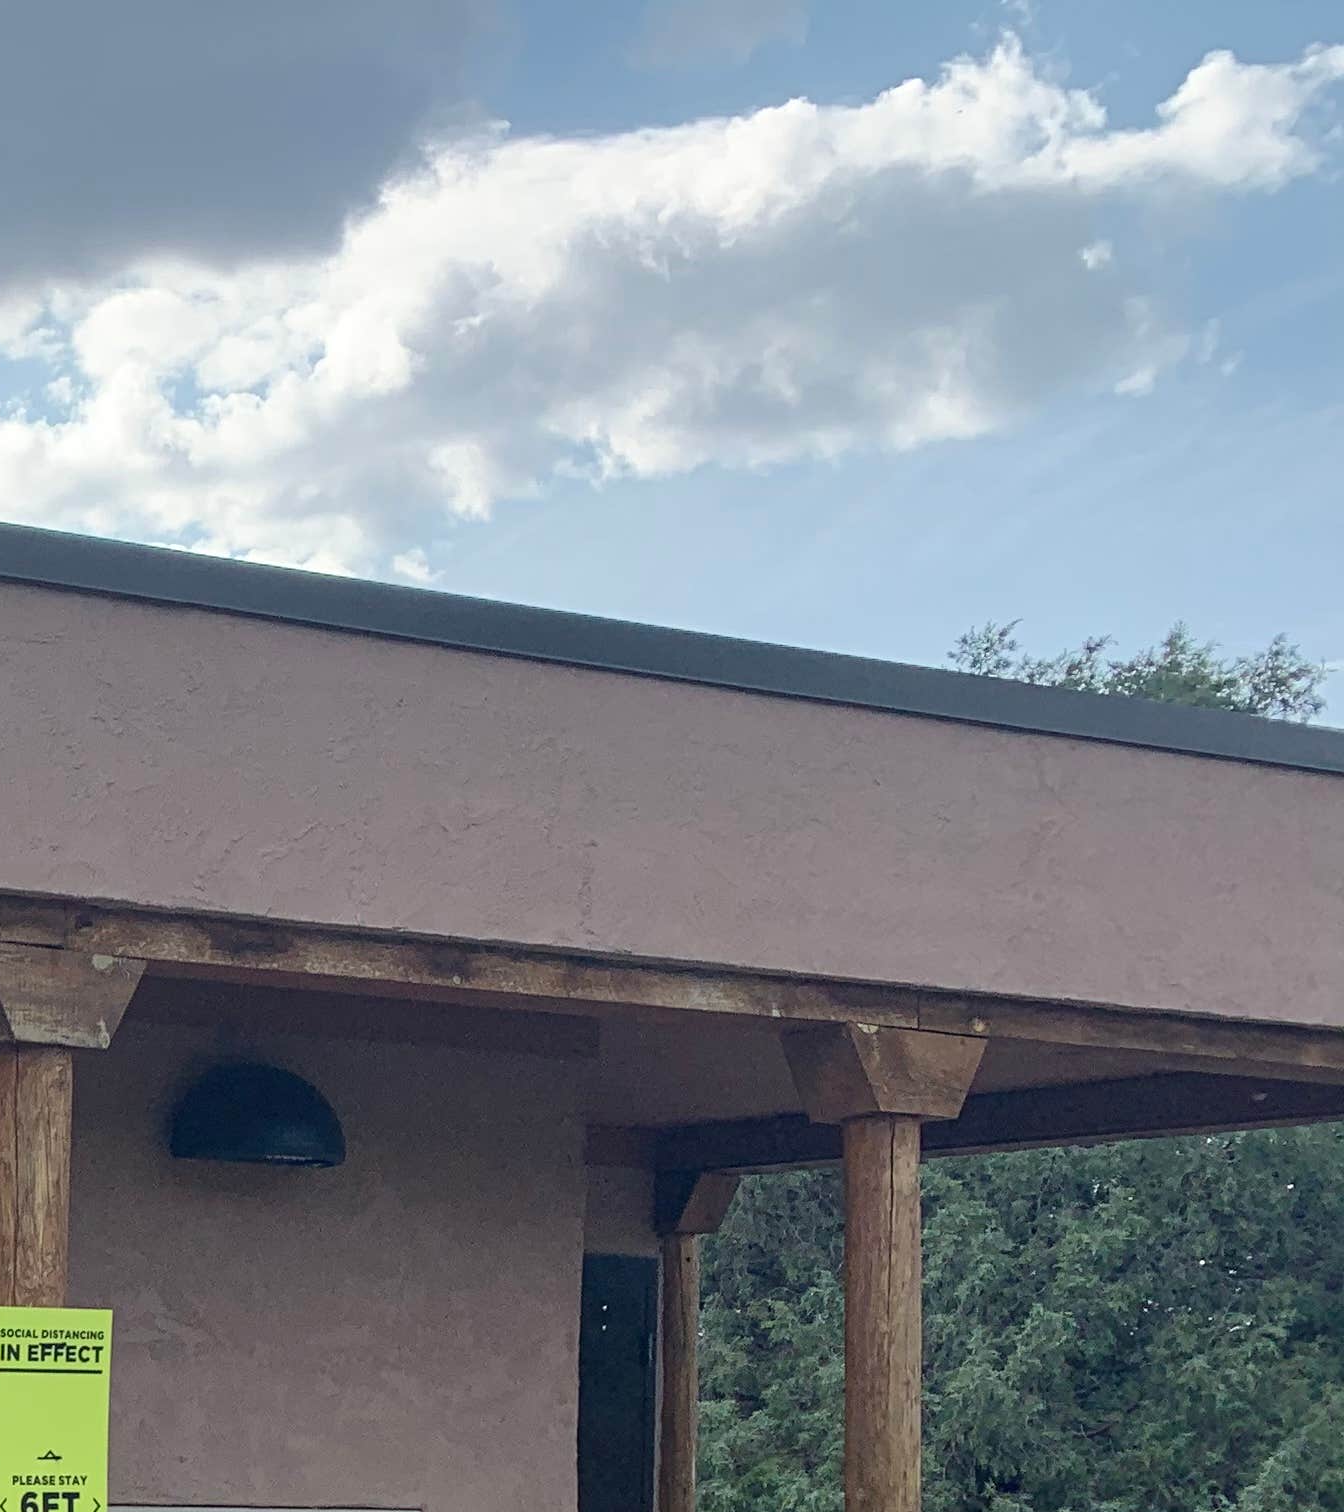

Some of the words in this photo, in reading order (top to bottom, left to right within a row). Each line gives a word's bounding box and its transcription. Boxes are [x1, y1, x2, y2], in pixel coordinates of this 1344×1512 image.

[0, 1328, 38, 1339] SOCIAL
[41, 1329, 104, 1340] DISTANCING
[0, 1343, 20, 1361] IN
[27, 1344, 104, 1363] EFFECT
[12, 1475, 55, 1486] PLEASE
[58, 1475, 88, 1486] STAY
